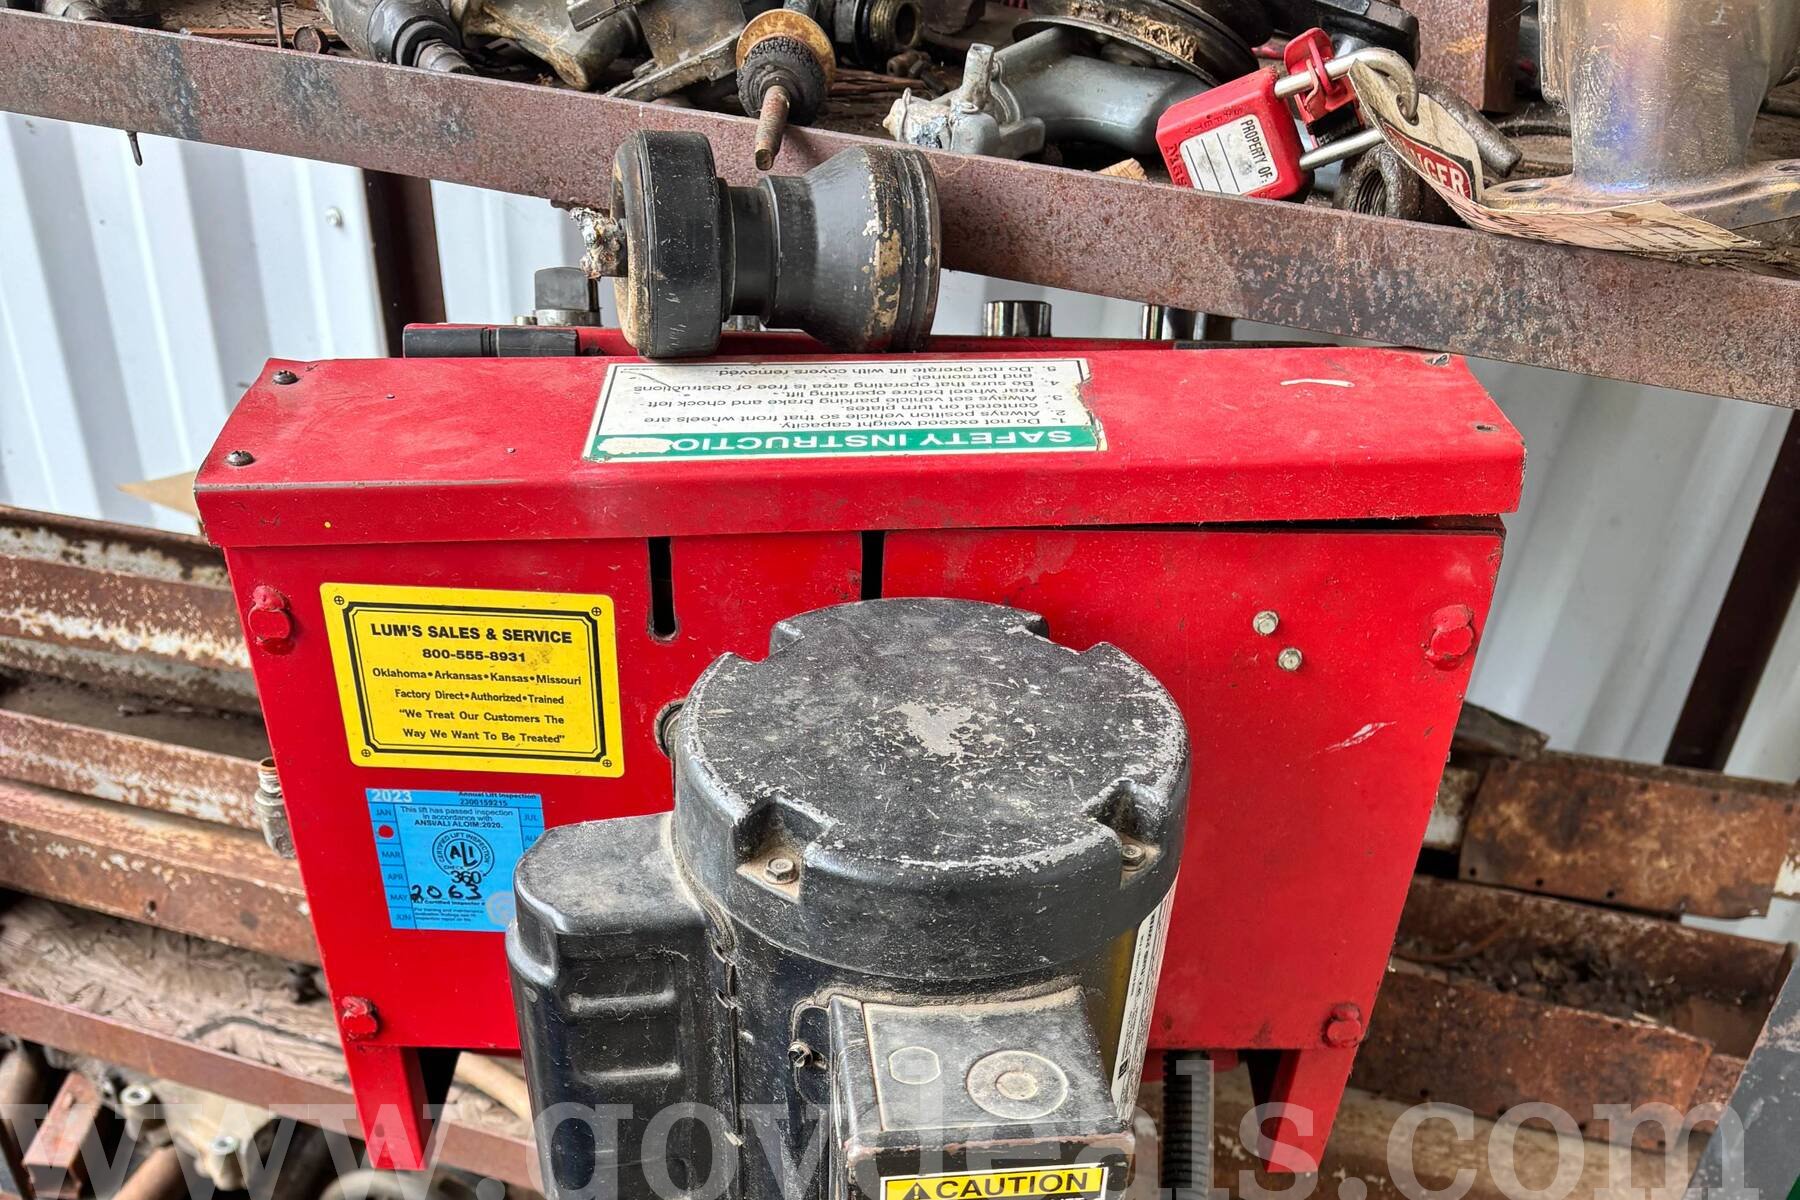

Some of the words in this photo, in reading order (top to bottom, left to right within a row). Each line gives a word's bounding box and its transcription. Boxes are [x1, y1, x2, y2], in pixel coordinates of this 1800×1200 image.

[1241, 119, 1268, 164] PROPERTY
[1258, 166, 1273, 184] OF:
[715, 368, 788, 376] removed.
[854, 381, 930, 389] operating
[809, 389, 886, 397] operating
[819, 396, 880, 405] parking
[979, 394, 1037, 402] Always
[842, 404, 896, 412] plates.
[965, 402, 1038, 410] centered
[910, 410, 975, 418] position
[676, 415, 735, 423] wheels
[857, 419, 912, 427] weight
[917, 418, 978, 426] exceed
[779, 421, 852, 429] capacity.
[671, 433, 907, 451] INSTRUCTIO
[920, 430, 1072, 446] SAFETY
[370, 623, 422, 638] LUM'S
[428, 626, 480, 640] SALES
[486, 628, 497, 640] &
[503, 629, 572, 643] SERVICE
[422, 648, 526, 663] 800-555-8931
[395, 688, 431, 701] Factory
[427, 709, 455, 720] Treat
[459, 711, 479, 722] Our
[484, 712, 540, 724] Customers
[544, 714, 564, 725] The
[402, 728, 425, 740] Way
[430, 729, 447, 740] We
[452, 730, 479, 741] Want
[483, 731, 498, 742] To
[501, 732, 516, 743] Be
[371, 789, 412, 803] 2023
[400, 805, 417, 813] This
[445, 807, 473, 816] passed
[474, 808, 513, 817] inspection
[432, 813, 475, 821] accordance
[382, 850, 401, 858] MAR
[450, 841, 478, 867] ALI
[450, 870, 482, 884] 360
[936, 1172, 1088, 1199] CAUTION
